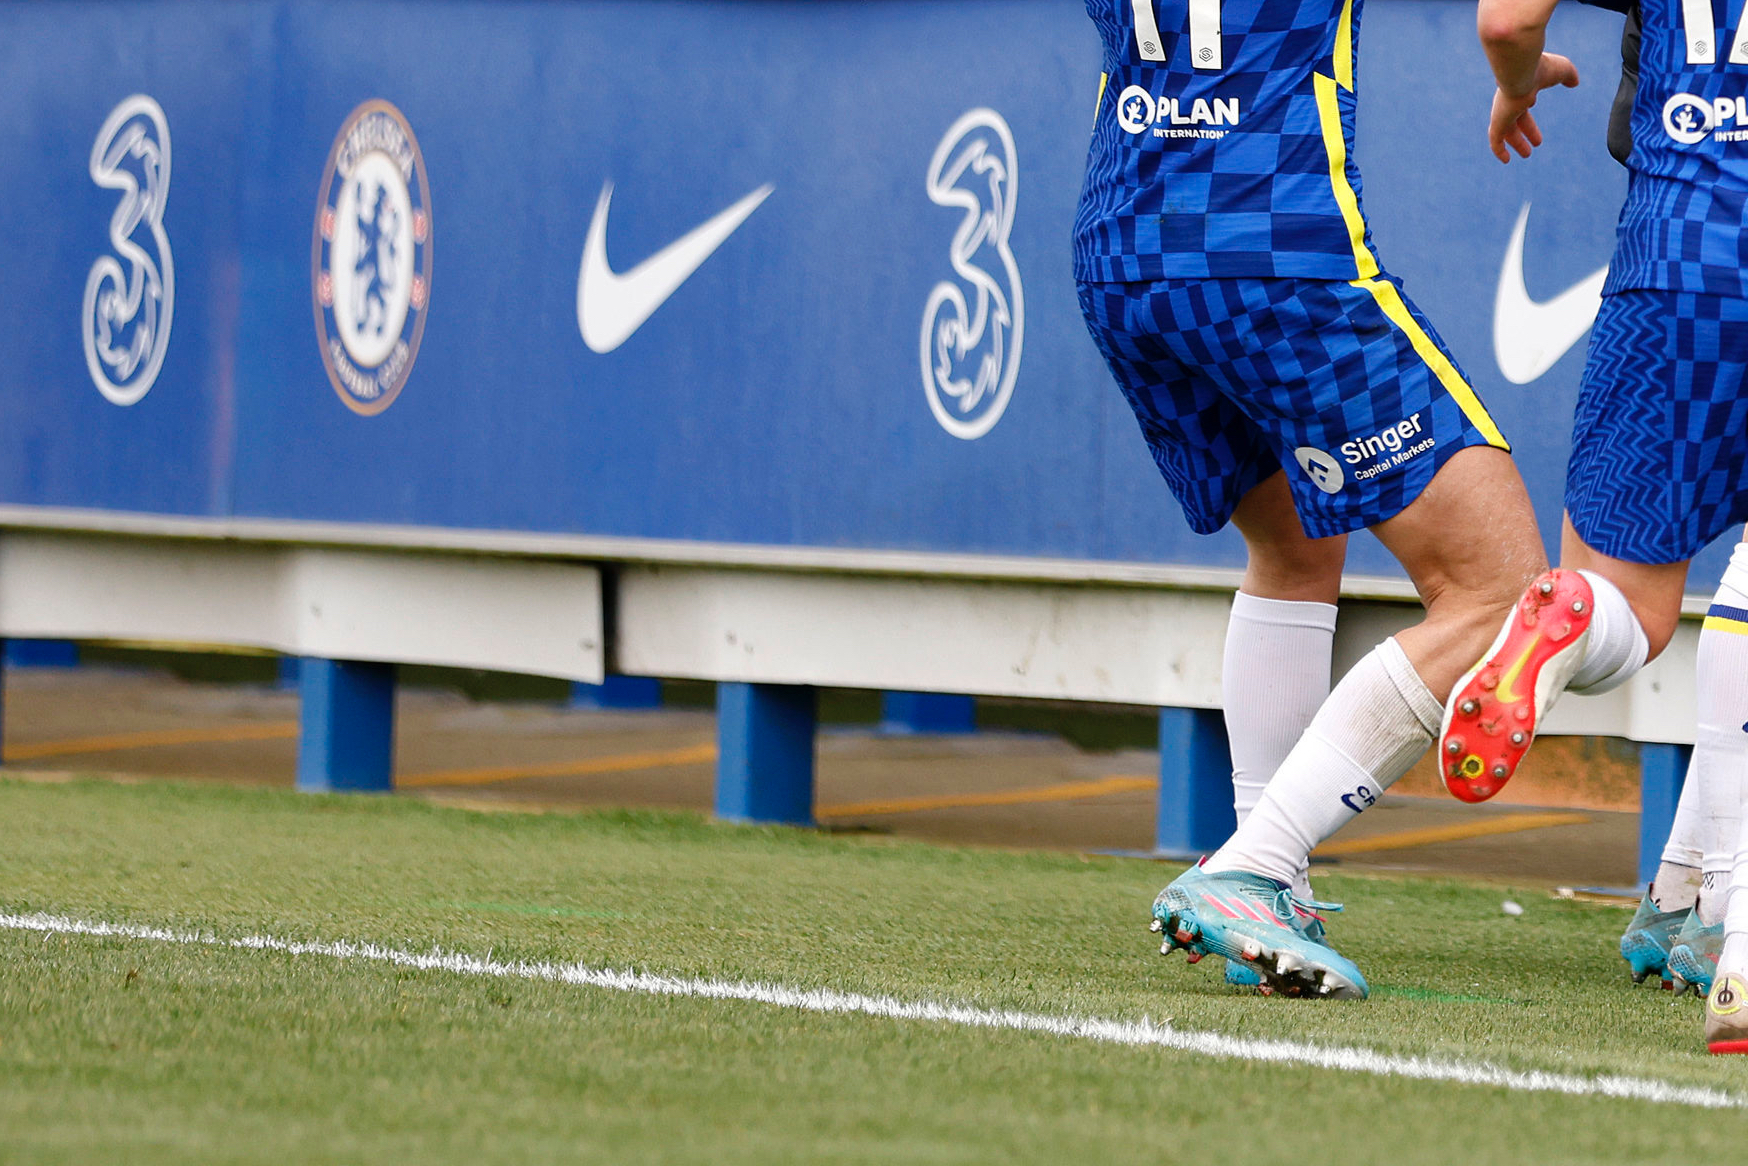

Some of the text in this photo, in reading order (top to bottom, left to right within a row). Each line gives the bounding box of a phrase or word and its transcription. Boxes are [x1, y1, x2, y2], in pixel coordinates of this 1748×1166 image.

[1156, 96, 1240, 126] PLAN
[1153, 128, 1230, 139] INTERNATION
[1340, 412, 1422, 464] Singer
[1354, 437, 1436, 480] Capital Markets
[1357, 786, 1376, 806] CF
